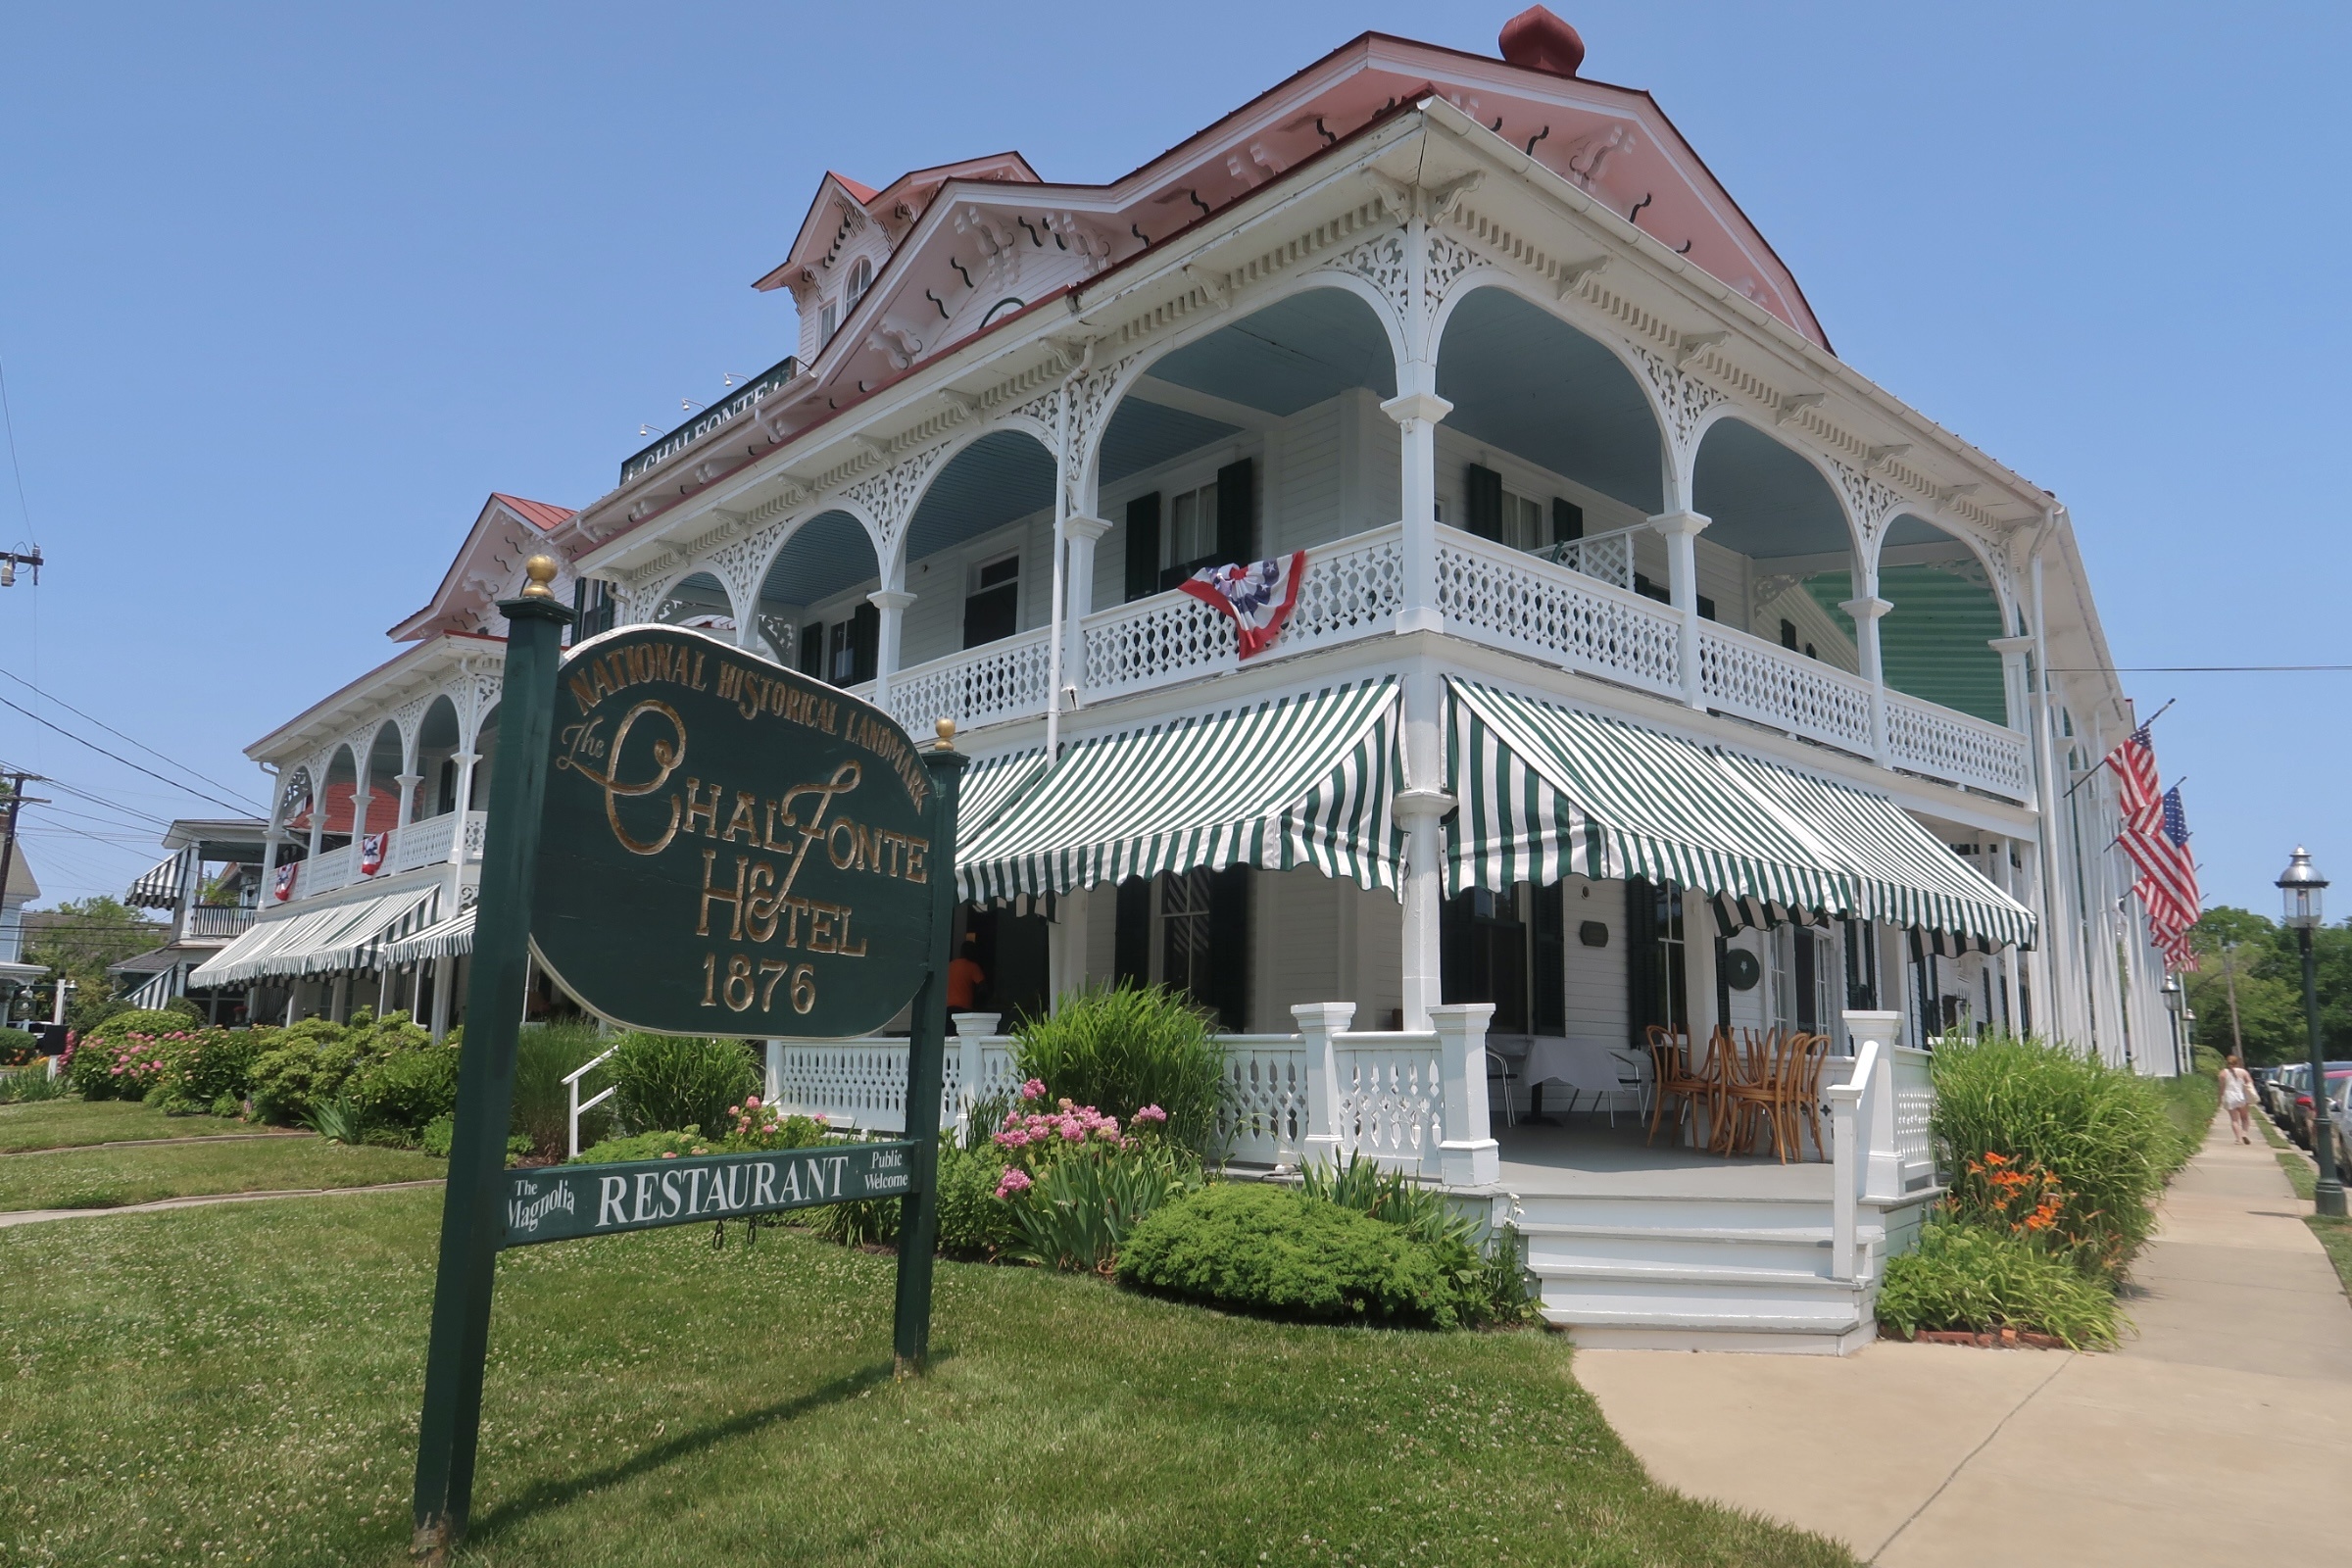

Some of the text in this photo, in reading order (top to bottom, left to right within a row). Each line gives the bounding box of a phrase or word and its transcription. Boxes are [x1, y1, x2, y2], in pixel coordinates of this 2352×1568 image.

[556, 715, 605, 770] The
[568, 643, 929, 815] NATIONAL HISTORICAL LANDMARK
[696, 849, 866, 956] HOTEL
[700, 953, 816, 1014] 1876
[864, 1173, 908, 1191] Welcome
[871, 1150, 903, 1169] Public
[508, 1179, 575, 1232] Magnolia
[514, 1179, 538, 1197] The
[595, 1156, 849, 1227] RESTAURANT
